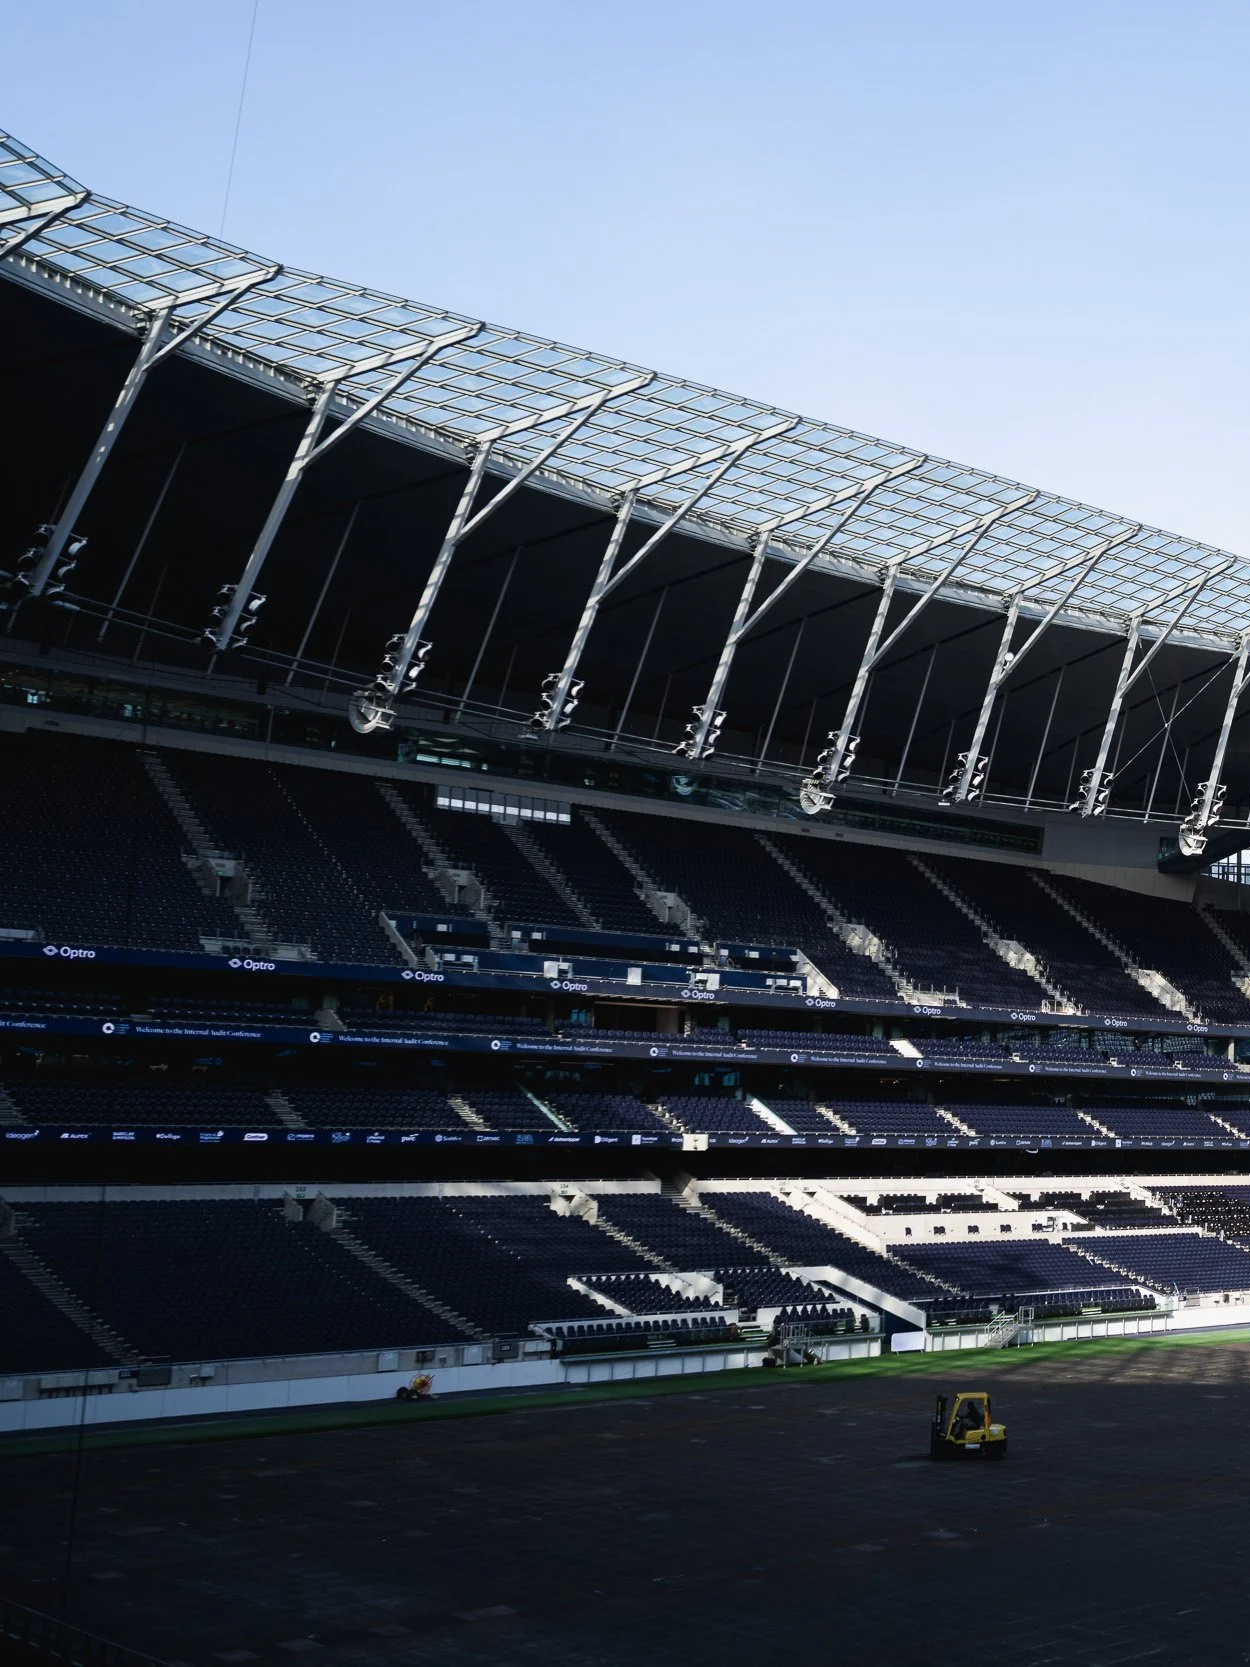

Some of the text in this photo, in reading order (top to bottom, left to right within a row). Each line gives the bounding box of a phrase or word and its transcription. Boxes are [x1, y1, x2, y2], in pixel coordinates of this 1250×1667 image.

[60, 946, 96, 960] Optro
[243, 958, 276, 972] Optro
[415, 971, 444, 983] Optro
[562, 981, 588, 992] Optro
[692, 989, 715, 1000] Optro
[815, 998, 836, 1009] Optro
[922, 1006, 942, 1016] Optro
[1018, 1012, 1036, 1022] Optro
[6, 1020, 46, 1028] Conference
[1111, 1019, 1128, 1029] Optro
[1193, 1025, 1208, 1034] Optro
[136, 1026, 164, 1034] Welcome
[227, 1030, 262, 1038] Conference
